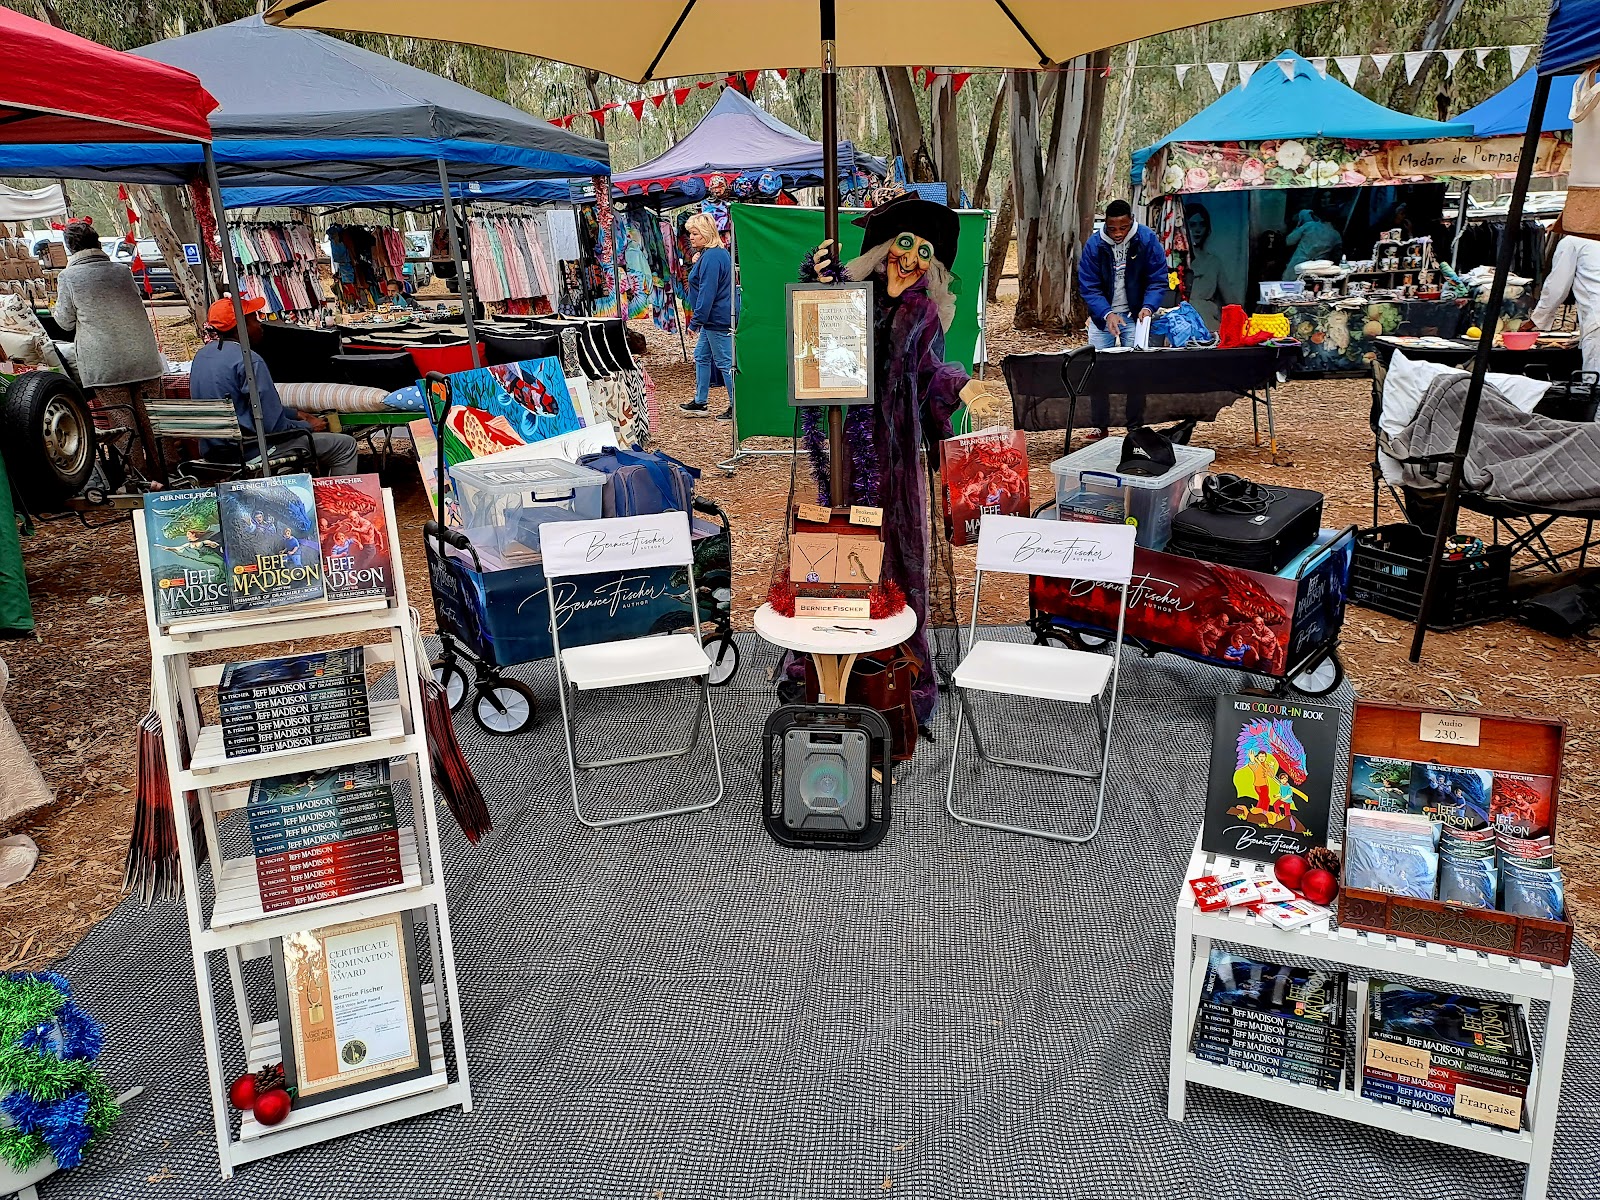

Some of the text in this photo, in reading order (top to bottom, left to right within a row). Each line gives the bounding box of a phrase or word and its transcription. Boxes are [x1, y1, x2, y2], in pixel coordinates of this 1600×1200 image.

[1399, 145, 1543, 169] Madam de Pompadr
[160, 491, 217, 501] BERNICE FISCH
[619, 529, 673, 555] Fischer
[1054, 537, 1112, 564] Fischer
[255, 554, 288, 578] JEFF
[326, 556, 354, 577] JEFF
[183, 569, 215, 592] JEFF
[232, 564, 320, 596] MADISON
[159, 583, 228, 609] MADISO
[594, 575, 666, 617] Fischer
[1129, 573, 1195, 611] Fischer
[622, 600, 648, 609] AUTHOR
[1144, 602, 1172, 613] AUTHOR
[253, 689, 267, 698] JEFF
[269, 683, 306, 695] MADISON
[254, 700, 269, 710] JEFF
[270, 695, 307, 707] MADISON
[256, 711, 270, 720] JEFF
[272, 705, 309, 718] MADISON
[1234, 702, 1324, 721] KIDS COLOUR-IN BOOK
[258, 722, 272, 731] JEFF
[273, 716, 311, 729] MADISON
[1438, 719, 1462, 727] Audio
[258, 733, 273, 742] JEFF
[274, 726, 311, 739] MADISON
[1434, 730, 1464, 740] 230.-
[260, 743, 274, 753] JEFF
[275, 737, 312, 750] MADISON
[281, 805, 295, 813] JEFF
[296, 797, 332, 810] MADISON
[1378, 796, 1397, 807] JEFF
[284, 817, 297, 826] JEFF
[299, 810, 336, 823] MADISON
[1437, 803, 1457, 821] JEFF
[286, 829, 299, 838] JEFF
[301, 821, 337, 834] MADISON
[1496, 814, 1514, 831] JEFF
[288, 841, 301, 849] JEFF
[303, 832, 339, 846] MADISON
[289, 846, 333, 861] JEFF MADISON
[290, 858, 333, 872] JEFF MADISON
[291, 868, 335, 882] JEFF MADISON
[292, 879, 336, 894] JEFF MADISON
[295, 897, 306, 905] JEFF
[307, 890, 338, 902] MADISON
[329, 940, 389, 959] CERTIFICATE
[330, 951, 394, 970] NOMINATION
[332, 969, 366, 982] AWARD
[334, 991, 358, 1000] Bernice
[361, 986, 383, 995] Fischer
[1232, 1008, 1246, 1016] JEFF
[1247, 1011, 1284, 1026] MADISON
[1234, 1019, 1248, 1027] JEFF
[1248, 1022, 1286, 1035] MADISON
[1233, 1029, 1246, 1038] JEFF
[1248, 1032, 1284, 1046] MADISON
[1406, 1036, 1422, 1047] JEFF
[1423, 1041, 1465, 1056] MADISON
[1232, 1039, 1284, 1056] JEFF MADISON
[1228, 1048, 1280, 1066] JEFF MADISON
[1372, 1048, 1424, 1070] Deutsch
[1227, 1058, 1279, 1076] JEFF MADISON
[1397, 1073, 1410, 1083] JEFF
[1411, 1077, 1446, 1091] MADISON
[1397, 1085, 1413, 1096] JEFF
[1414, 1090, 1455, 1105] MADISON
[1397, 1096, 1411, 1107] JEFF
[1412, 1100, 1451, 1115] MADISON
[1459, 1094, 1516, 1117] Française
